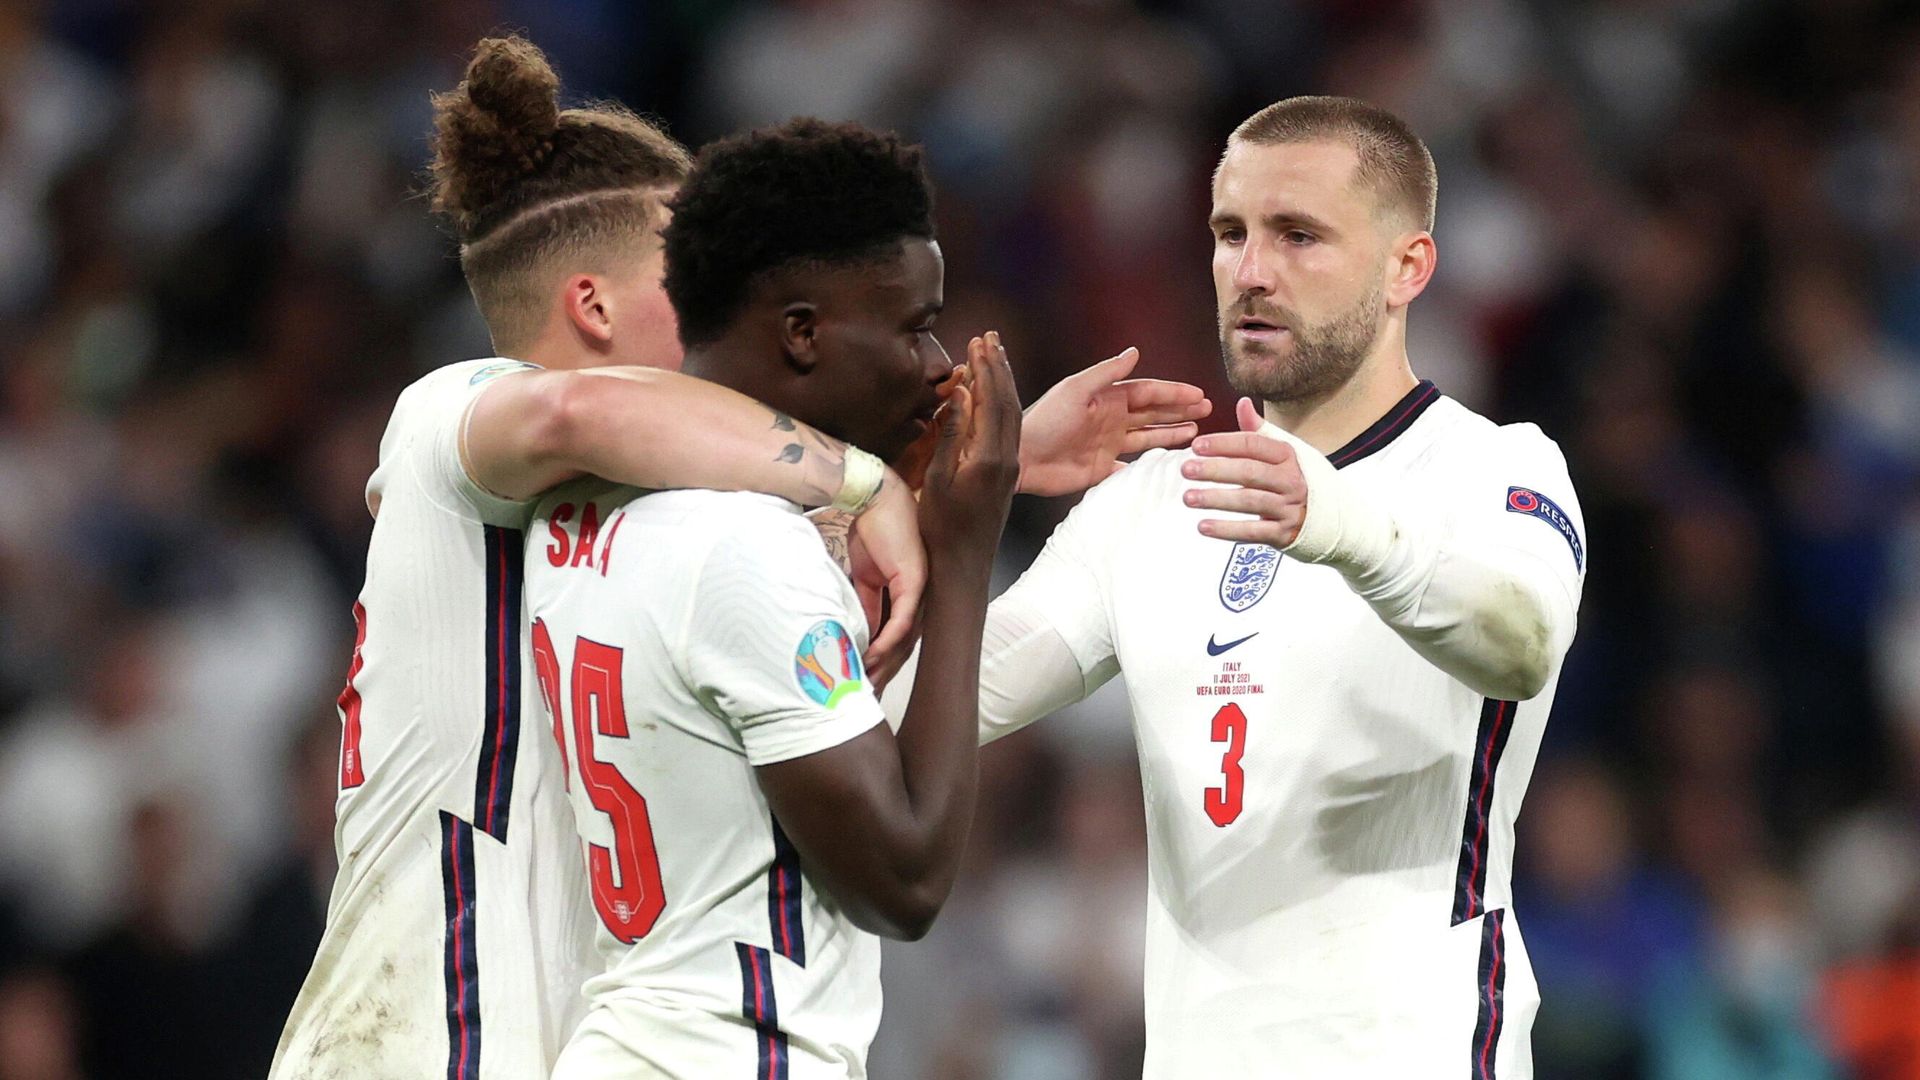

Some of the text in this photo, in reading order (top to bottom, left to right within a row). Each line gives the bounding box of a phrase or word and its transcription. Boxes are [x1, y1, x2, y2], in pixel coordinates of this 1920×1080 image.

[1540, 502, 1582, 565] RESPEC
[1222, 662, 1242, 672] ITALY
[1219, 673, 1236, 684] JULY
[1236, 673, 1251, 683] 2021
[1196, 684, 1264, 696] UEFA EURO 2020 FINAL
[1204, 702, 1248, 828] 3
